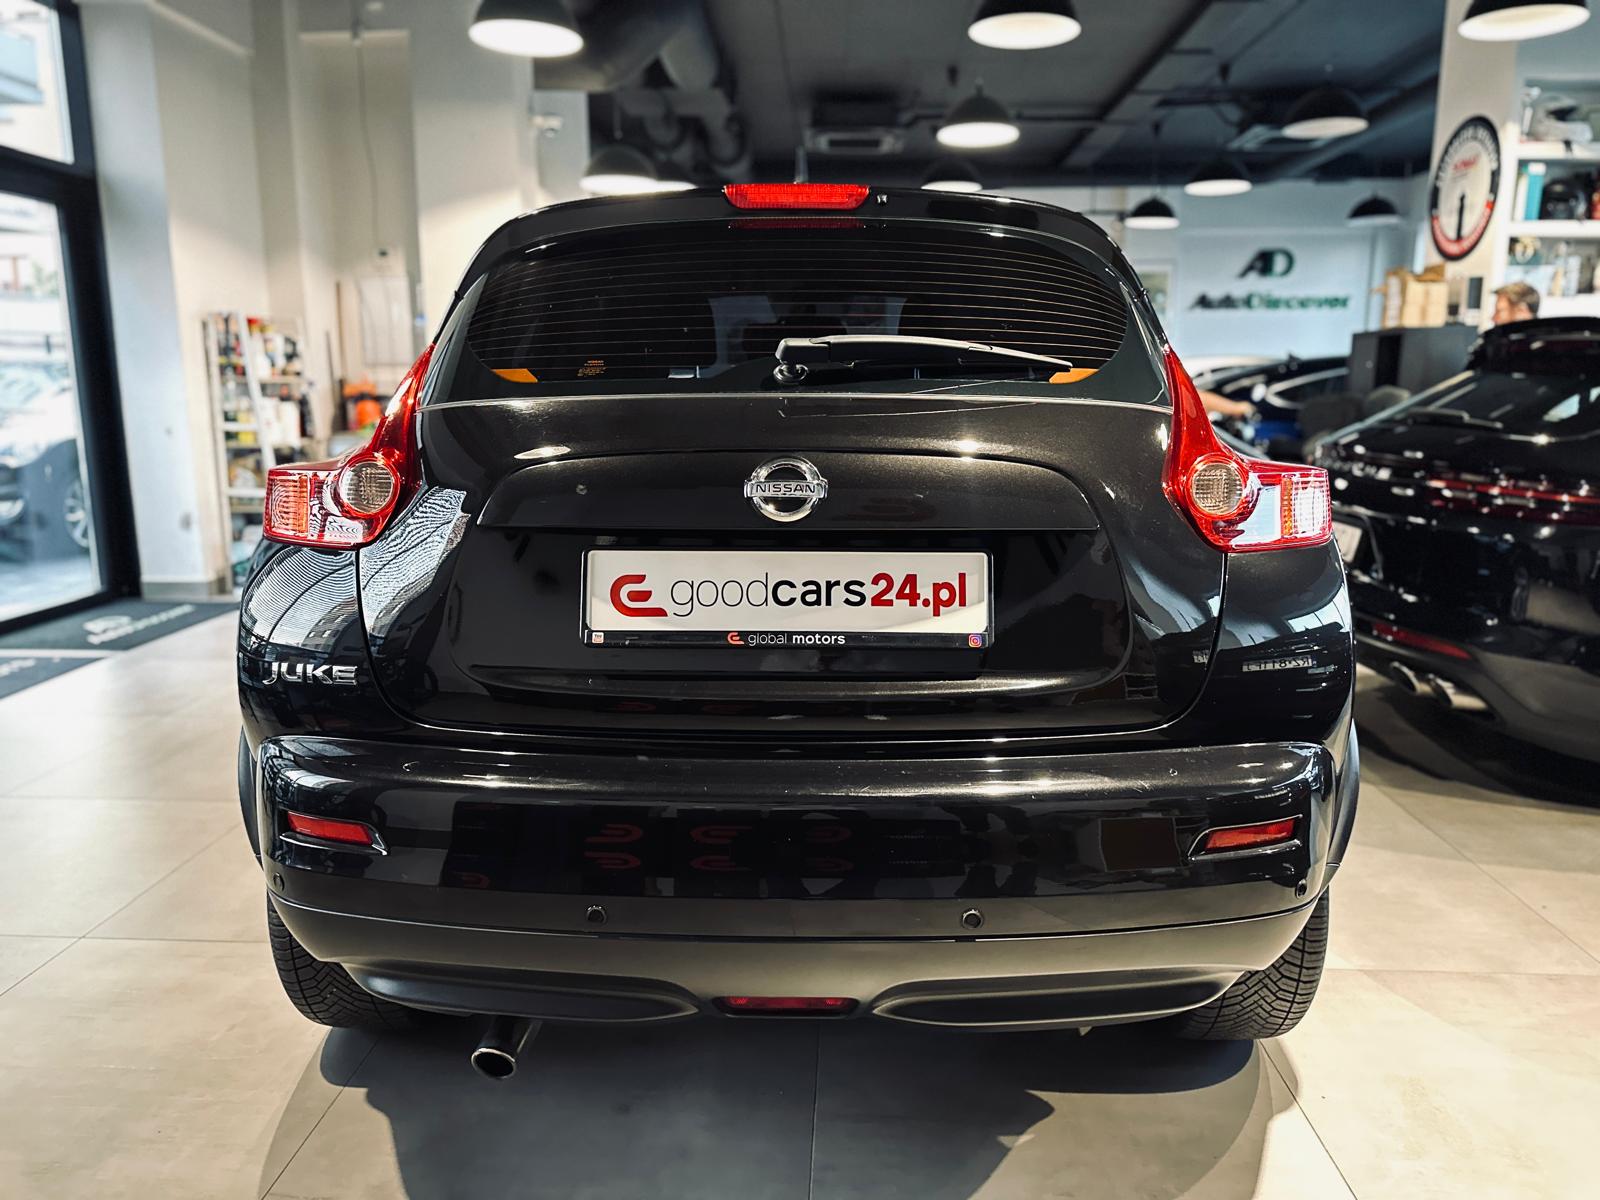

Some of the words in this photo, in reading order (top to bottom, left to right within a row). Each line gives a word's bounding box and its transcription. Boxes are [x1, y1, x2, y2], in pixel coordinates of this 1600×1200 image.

[756, 483, 816, 494] NISSAN
[670, 572, 967, 617] goodcars24.pl
[748, 633, 787, 646] global
[792, 633, 846, 645] motors
[262, 661, 358, 685] JUKE
